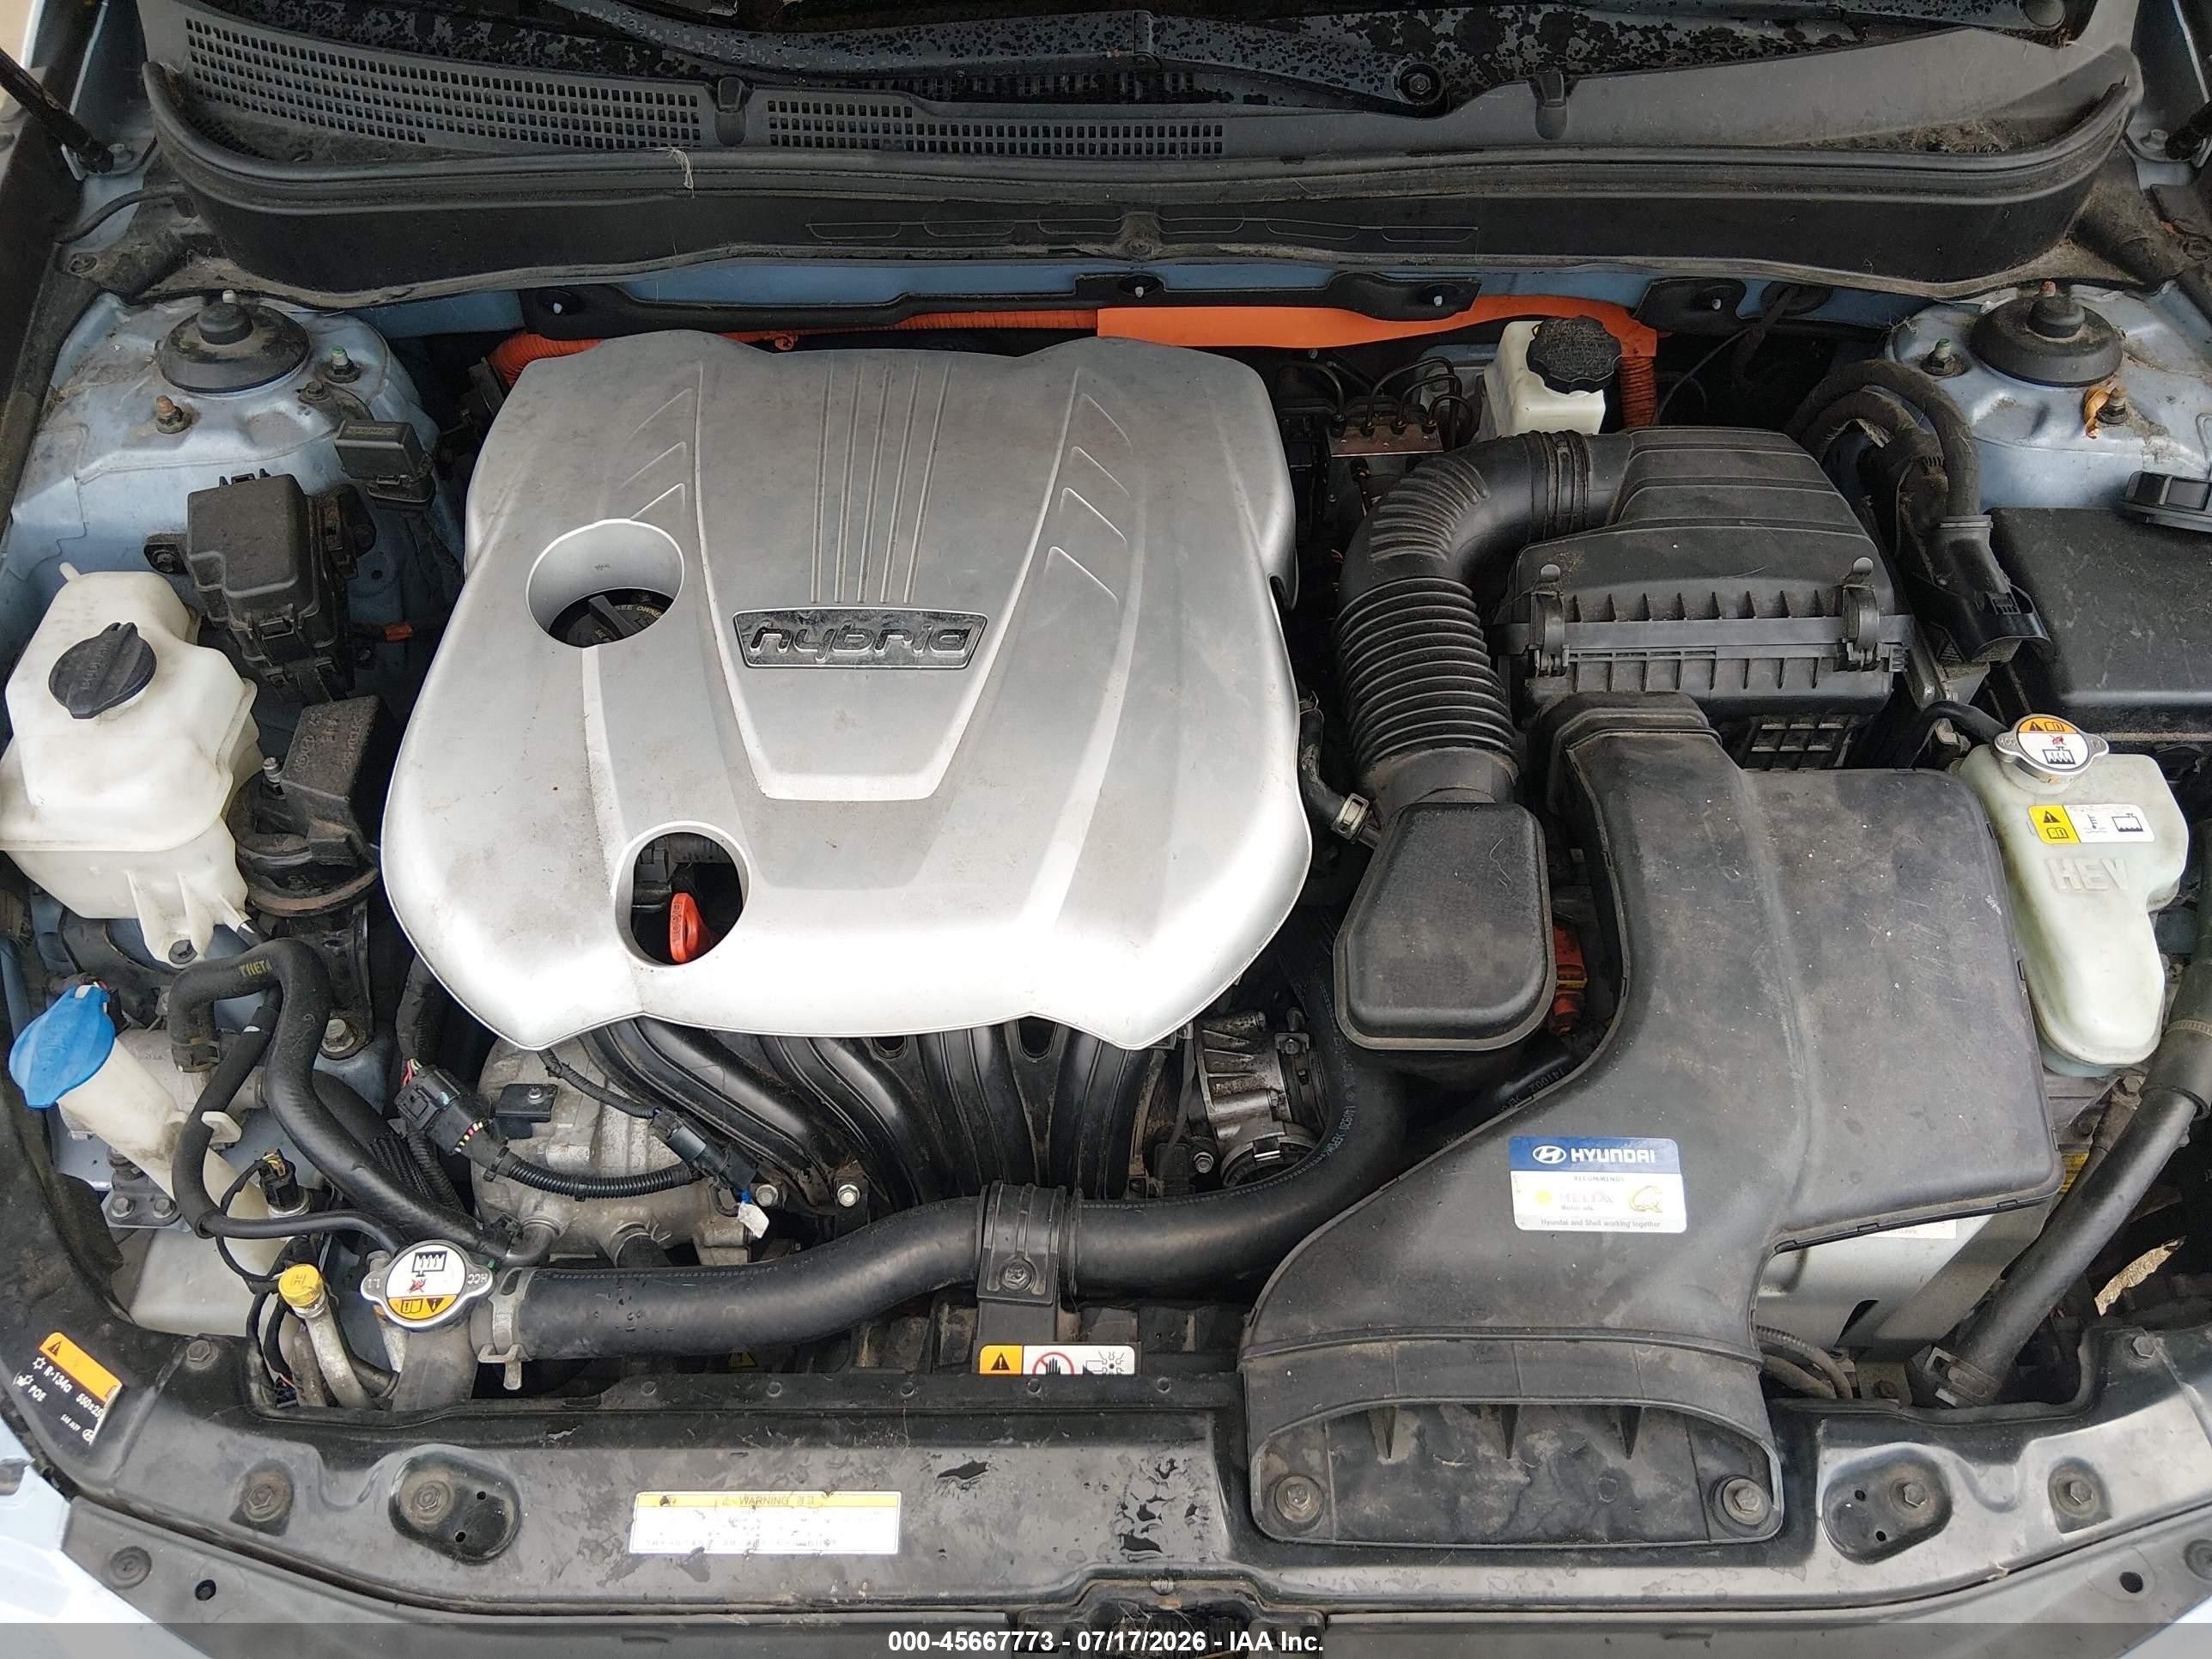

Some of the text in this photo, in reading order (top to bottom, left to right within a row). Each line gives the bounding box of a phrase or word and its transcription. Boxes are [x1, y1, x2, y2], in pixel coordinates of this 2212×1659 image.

[749, 620, 976, 663] hybrid
[2044, 857, 2130, 893] HEV
[1571, 1147, 1656, 1164] HYUNDAI
[1540, 1218, 1569, 1227] Hyundai
[1603, 1219, 1631, 1229] working
[1632, 1220, 1661, 1229] together
[43, 1364, 74, 1394] R-134a
[738, 1495, 789, 1506] WARNING
